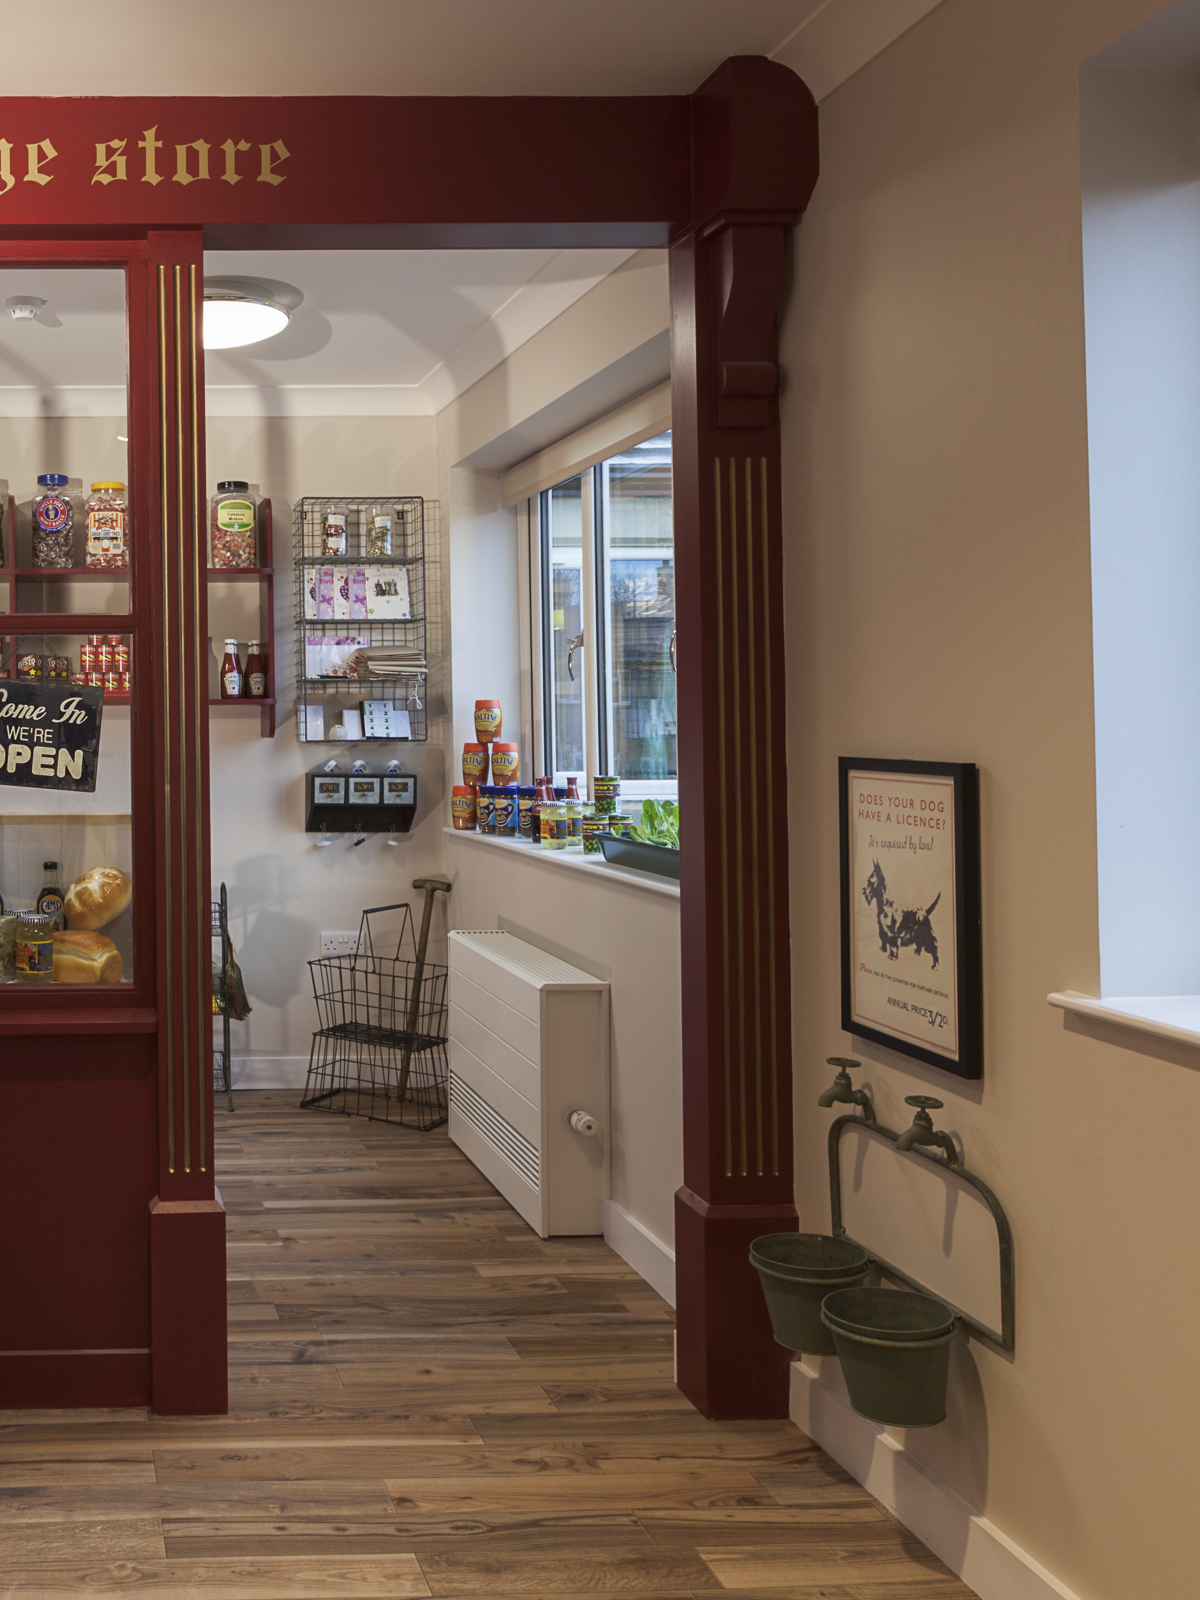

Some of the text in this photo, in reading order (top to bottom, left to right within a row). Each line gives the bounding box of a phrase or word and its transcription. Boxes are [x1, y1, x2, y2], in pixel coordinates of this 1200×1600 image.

[91, 124, 292, 187] store
[39, 499, 65, 511] UNCLE JOE'S
[40, 515, 65, 526] MINT BALLS
[52, 697, 88, 725] In
[6, 725, 54, 743] WE'RE
[859, 793, 945, 813] DOES YOUR DOG
[858, 809, 946, 830] HAVE A LICENCE?
[868, 834, 934, 854] It's required by law!
[40, 900, 62, 914] CAMP
[892, 976, 909, 986] COUNTER
[917, 984, 933, 994] FURTHER
[887, 996, 910, 1012] ANNUAL
[911, 1004, 928, 1018] PRICE
